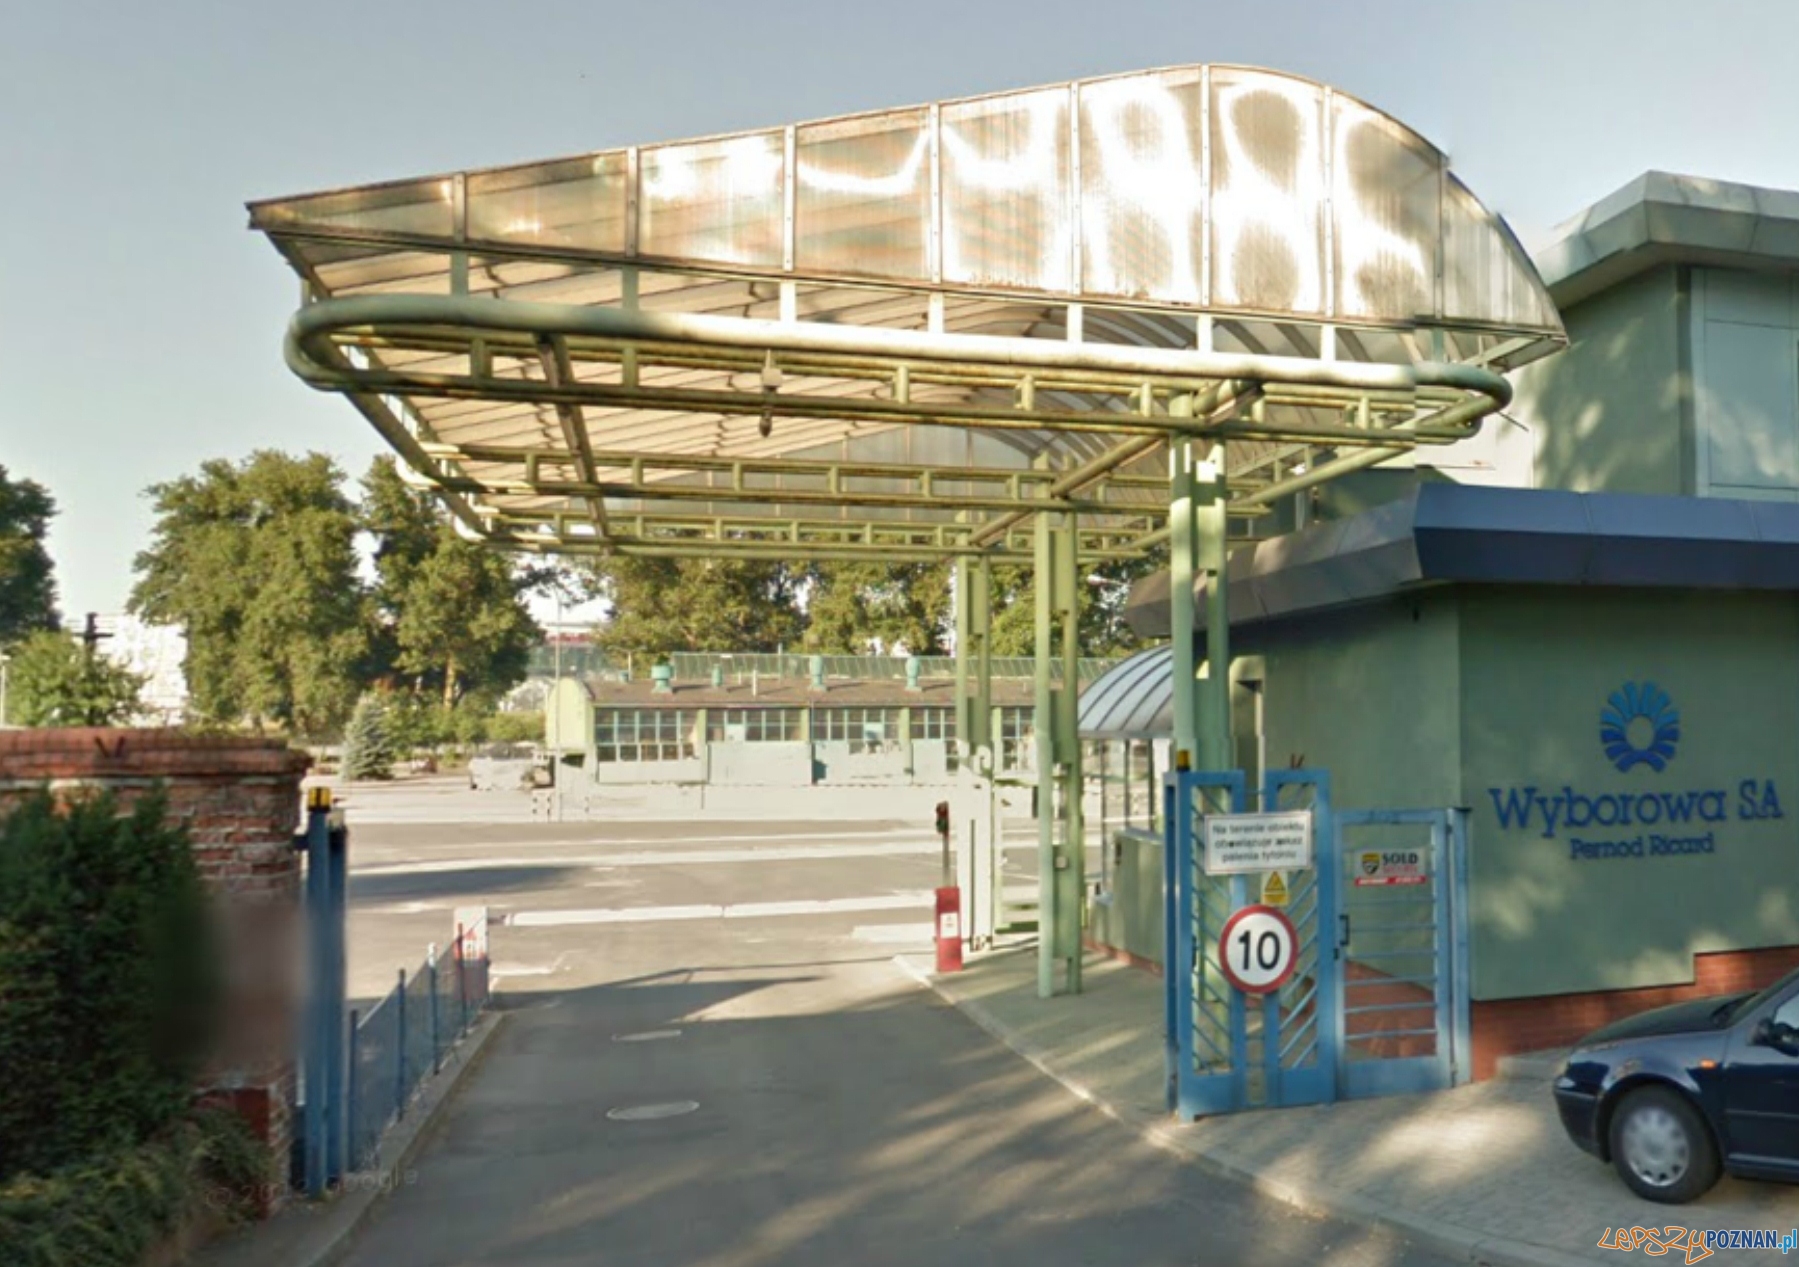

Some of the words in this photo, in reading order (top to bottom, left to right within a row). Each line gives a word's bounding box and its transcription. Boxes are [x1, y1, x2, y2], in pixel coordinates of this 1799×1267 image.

[1488, 785, 1728, 839] Wyborowa
[1738, 779, 1784, 822] SA
[1570, 836, 1644, 860] Pernod
[1649, 831, 1715, 856] Ricard
[1238, 930, 1281, 971] 10
